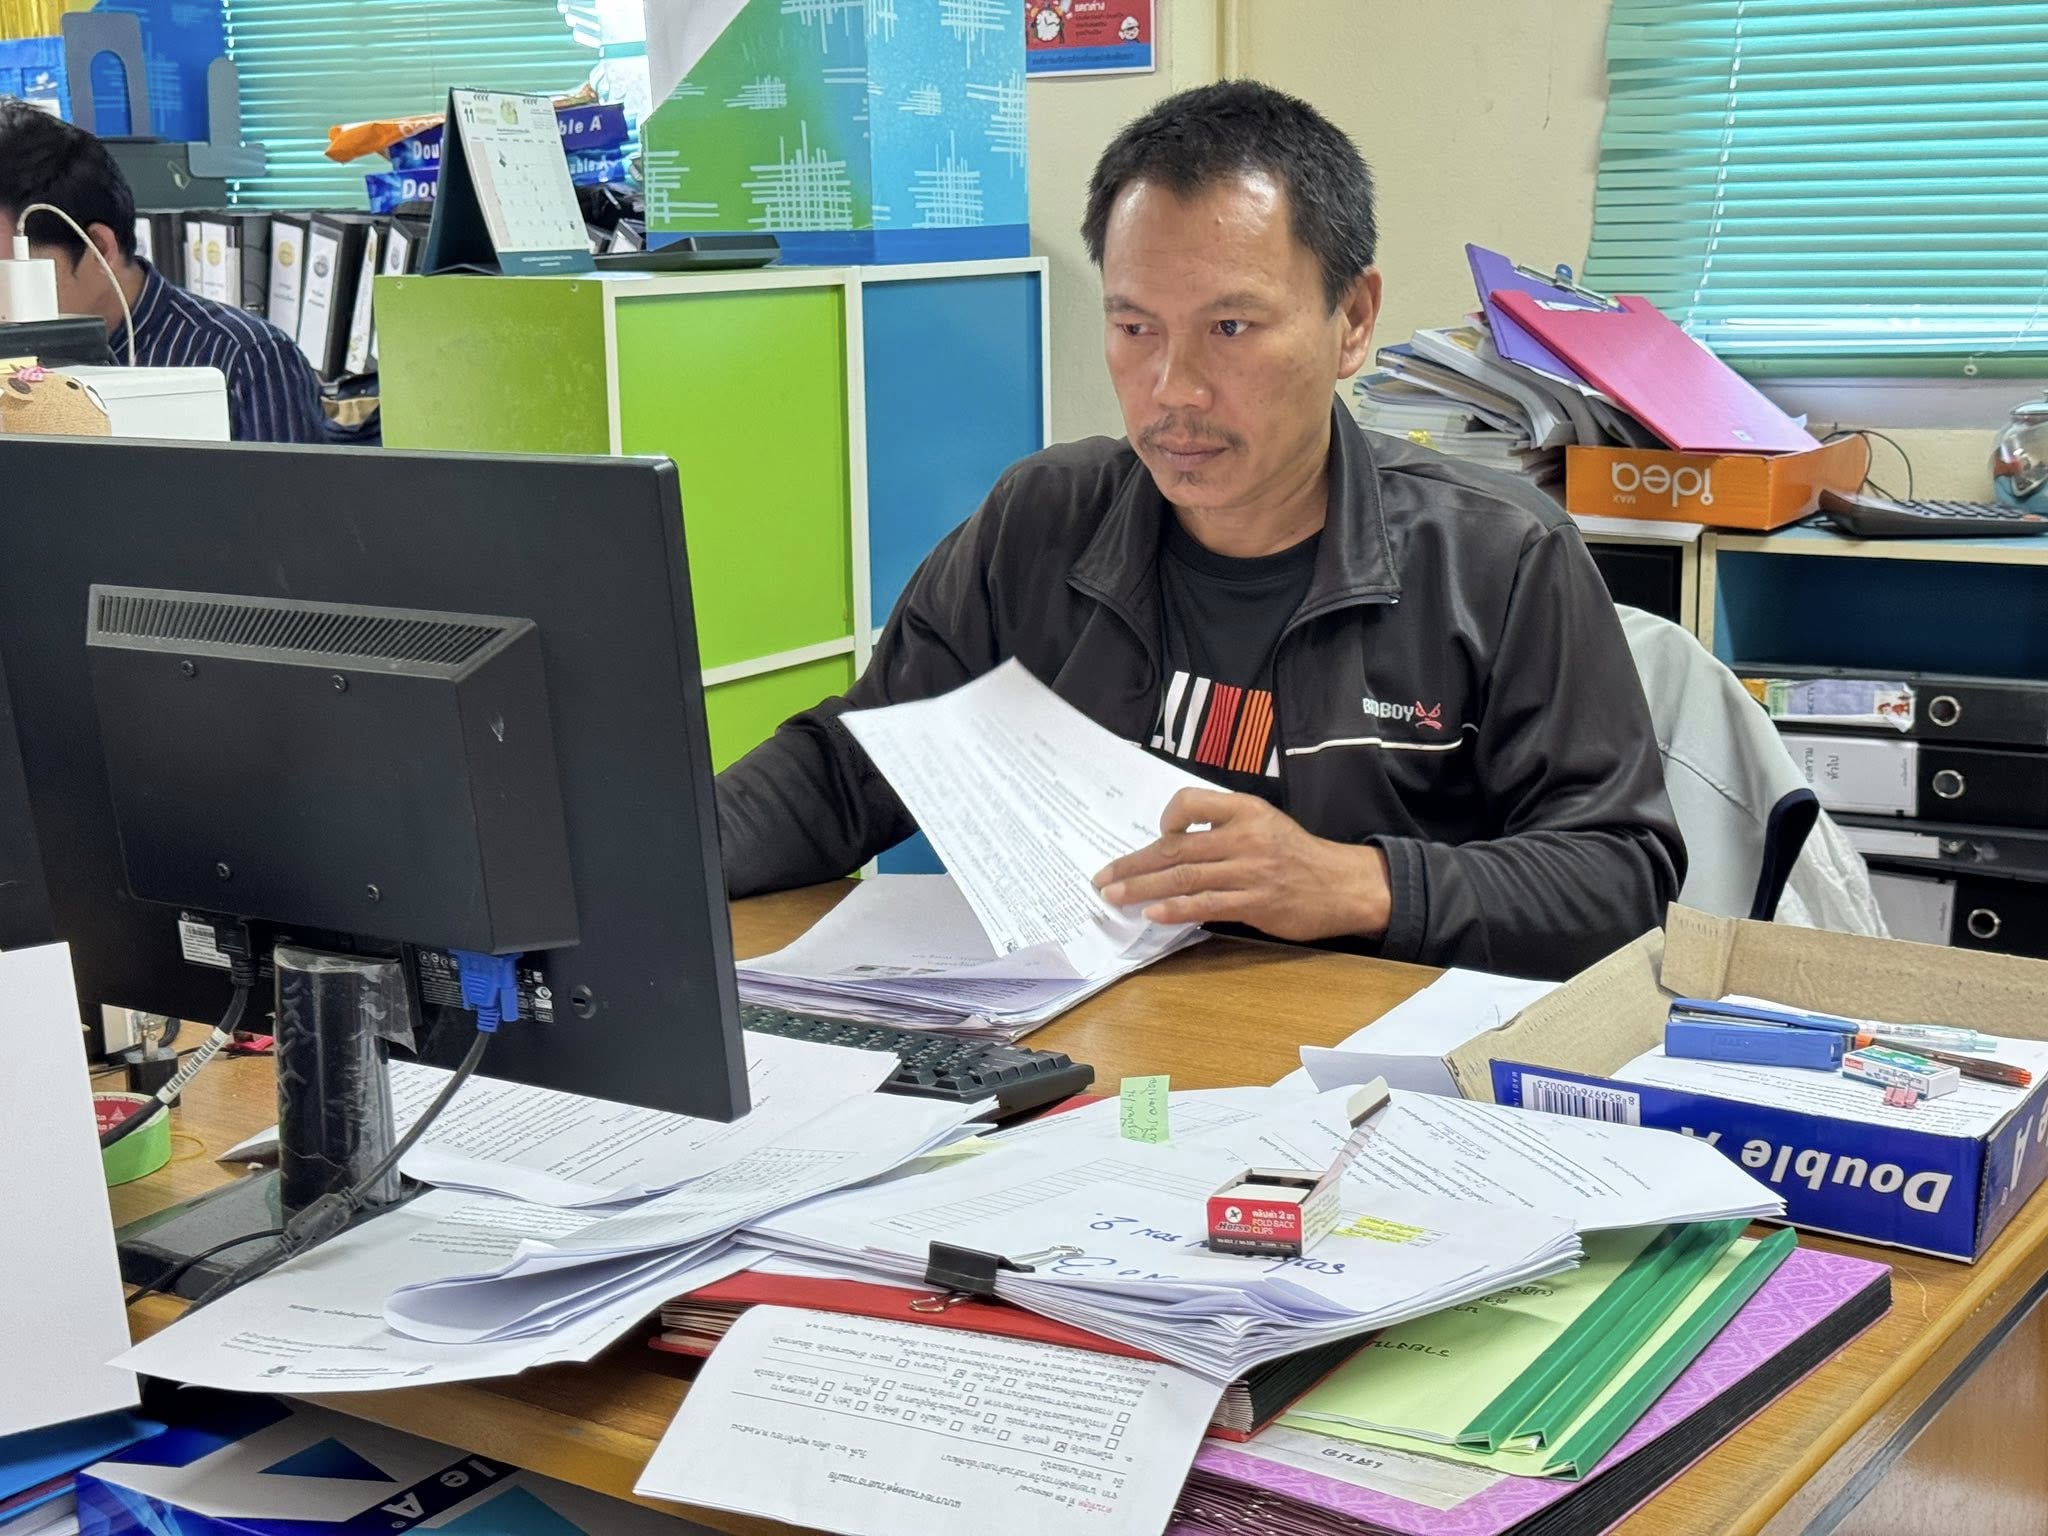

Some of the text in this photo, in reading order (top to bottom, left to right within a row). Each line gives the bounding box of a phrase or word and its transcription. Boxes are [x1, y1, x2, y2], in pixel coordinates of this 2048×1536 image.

[589, 116, 602, 131] A
[1611, 461, 1713, 508] idea
[1740, 1137, 1953, 1215] Double
[1214, 1221, 1251, 1232] Horse
[1252, 1218, 1294, 1229] FOLD BACK
[1252, 1225, 1274, 1235] CLIPS
